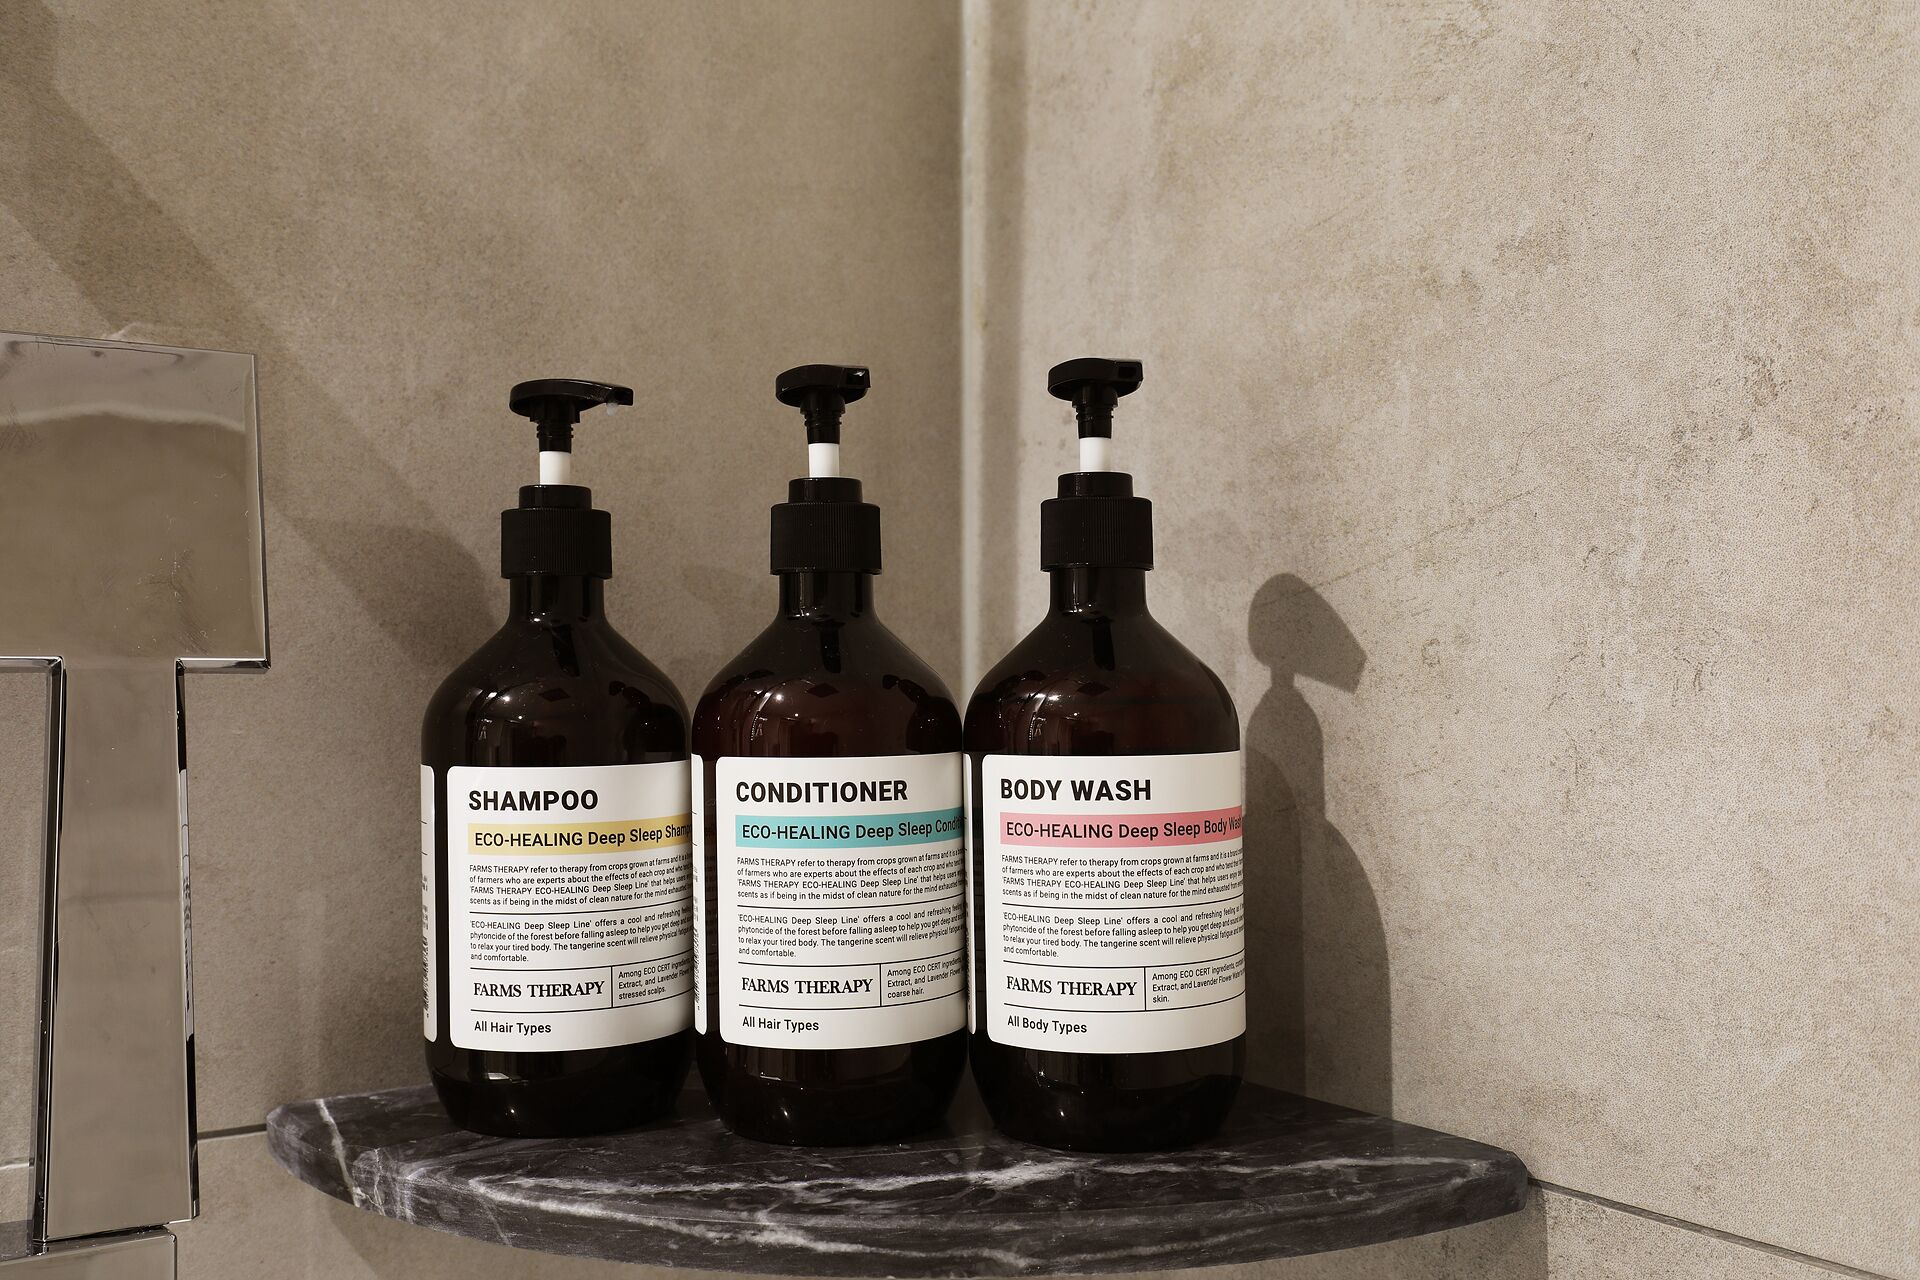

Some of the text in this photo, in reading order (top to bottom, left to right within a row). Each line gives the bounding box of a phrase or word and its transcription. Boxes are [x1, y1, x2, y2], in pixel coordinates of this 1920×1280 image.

[736, 779, 908, 803] CONDITIONER
[1000, 778, 1151, 801] BODY WASH
[468, 789, 598, 811] SHAMPOO
[475, 831, 582, 847] ECO-HEALING
[588, 831, 625, 847] Deep
[629, 827, 662, 843] Sleep
[742, 824, 850, 839] ECO-HEALING
[855, 824, 894, 841] Deep
[899, 822, 932, 838] Sleep
[1006, 821, 1113, 838] ECO-HEALING
[1118, 823, 1159, 841] Deep
[1163, 821, 1200, 839] Sleep
[1204, 817, 1227, 837] Body
[469, 864, 492, 873] FARMS
[493, 865, 529, 873] THERAPY
[530, 865, 548, 873] refer
[559, 865, 588, 873] therapy
[589, 863, 607, 871] from
[608, 863, 628, 871] crops
[628, 861, 648, 870] grown
[1001, 865, 1008, 873] of
[1009, 865, 1033, 875] farmers
[1035, 868, 1050, 876] who
[1065, 870, 1095, 878] experts
[1097, 869, 1120, 877] about
[1122, 869, 1134, 877] the
[1136, 868, 1163, 876] effects
[1164, 867, 1172, 875] of
[1173, 866, 1190, 875] each
[496, 886, 532, 894] THERAPY
[535, 885, 589, 894] ECO-HEALING
[592, 885, 611, 893] Deep
[613, 882, 633, 891] Sleep
[1026, 878, 1061, 887] THERAPY
[1064, 880, 1120, 888] ECO-HEALING
[1123, 880, 1143, 889] Deep
[1146, 879, 1167, 888] Sleep
[1187, 877, 1200, 885] that
[469, 897, 491, 905] scents
[502, 897, 508, 905] if
[509, 897, 530, 907] being
[540, 897, 553, 905] the
[555, 896, 577, 905] midst
[578, 895, 587, 904] of
[588, 895, 609, 903] clean
[610, 894, 633, 902] nature
[633, 891, 643, 899] for
[791, 916, 811, 926] Deep
[815, 916, 837, 926] Sleep
[862, 914, 886, 923] offers
[896, 911, 911, 921] cool
[1054, 916, 1074, 926] Deep
[1077, 916, 1100, 926] Sleep
[1126, 916, 1150, 925] offers
[1161, 914, 1177, 923] cool
[738, 925, 773, 934] phytoncide
[774, 926, 782, 934] of
[784, 927, 796, 935] the
[797, 927, 820, 935] forest
[821, 927, 847, 935] before
[848, 926, 872, 935] falling
[873, 924, 897, 934] asleep
[906, 921, 920, 931] help
[920, 921, 931, 930] you
[745, 936, 761, 944] relax
[779, 938, 796, 946] tired
[820, 938, 836, 946] The
[837, 937, 873, 947] tangerine
[875, 935, 895, 944] scent
[895, 933, 908, 942] will
[618, 969, 642, 979] Among
[886, 968, 911, 977] Among
[1151, 972, 1177, 981] Among
[1179, 969, 1193, 978] ECO
[473, 980, 605, 997] FARMS THERAPY
[741, 977, 873, 994] FARMS THERAPY
[1006, 975, 1137, 996] FARMS THERAPY
[1180, 980, 1192, 990] and
[474, 1020, 551, 1036] All Hair Types
[742, 1016, 819, 1033] All Hair Types
[1007, 1015, 1087, 1035] All Body Types
